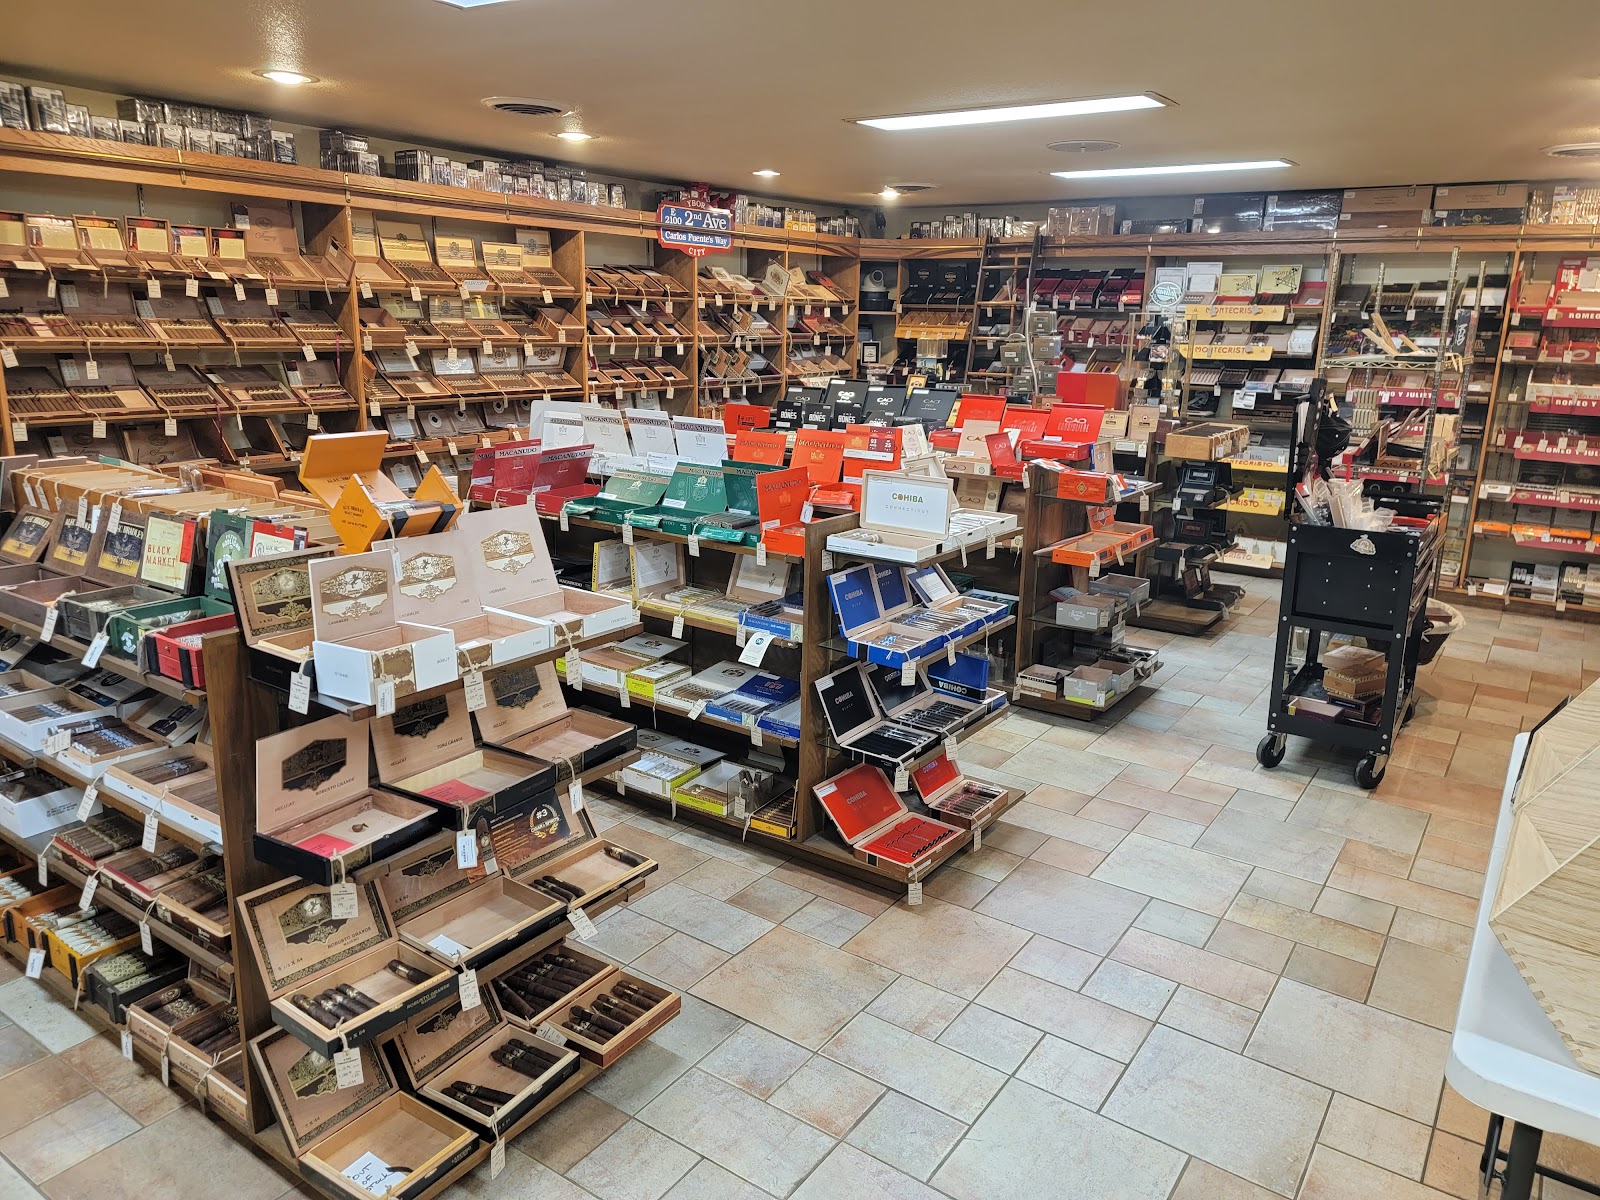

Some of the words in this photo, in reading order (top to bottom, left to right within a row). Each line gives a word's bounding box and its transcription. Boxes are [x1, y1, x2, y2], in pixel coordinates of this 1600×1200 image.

[687, 199, 706, 209] YBOR
[670, 207, 677, 216] E
[664, 215, 682, 225] 2100
[684, 210, 702, 226] 2nd
[702, 213, 727, 230] Ave
[664, 230, 687, 241] Carlos
[688, 233, 714, 243] Fuente's
[714, 235, 728, 247] Way
[688, 247, 706, 256] CITY
[838, 390, 855, 398] CAO
[1405, 391, 1433, 399] JULIET
[584, 415, 620, 424] MACANUDO
[780, 410, 798, 420] BONES
[808, 413, 826, 422] BONES
[837, 414, 856, 424] BONES
[629, 416, 667, 426] MACANUDO
[680, 422, 718, 433] MACANUDO
[499, 447, 537, 457] MACANUDO
[547, 451, 587, 461] MACANUDO
[688, 467, 723, 477] MACANUDO
[891, 492, 924, 504] COHIBA
[959, 495, 981, 504] CAO
[147, 544, 171, 556] BLACK
[145, 555, 176, 568] MARKET
[844, 588, 864, 601] COHIBA
[938, 680, 968, 695] COHIBA
[834, 690, 854, 705] COHIBA
[314, 783, 336, 796] ROBUSTO
[335, 776, 355, 790] GRANDE
[846, 790, 868, 805] COHIBA
[274, 800, 296, 813] HELLCAT
[535, 808, 549, 820] #3
[327, 936, 350, 949] ROBUSTO
[350, 926, 372, 939] GRANDE
[406, 992, 432, 1010] ROBUSTO
[431, 982, 450, 997] GRANDE
[351, 1162, 372, 1180] OUT
